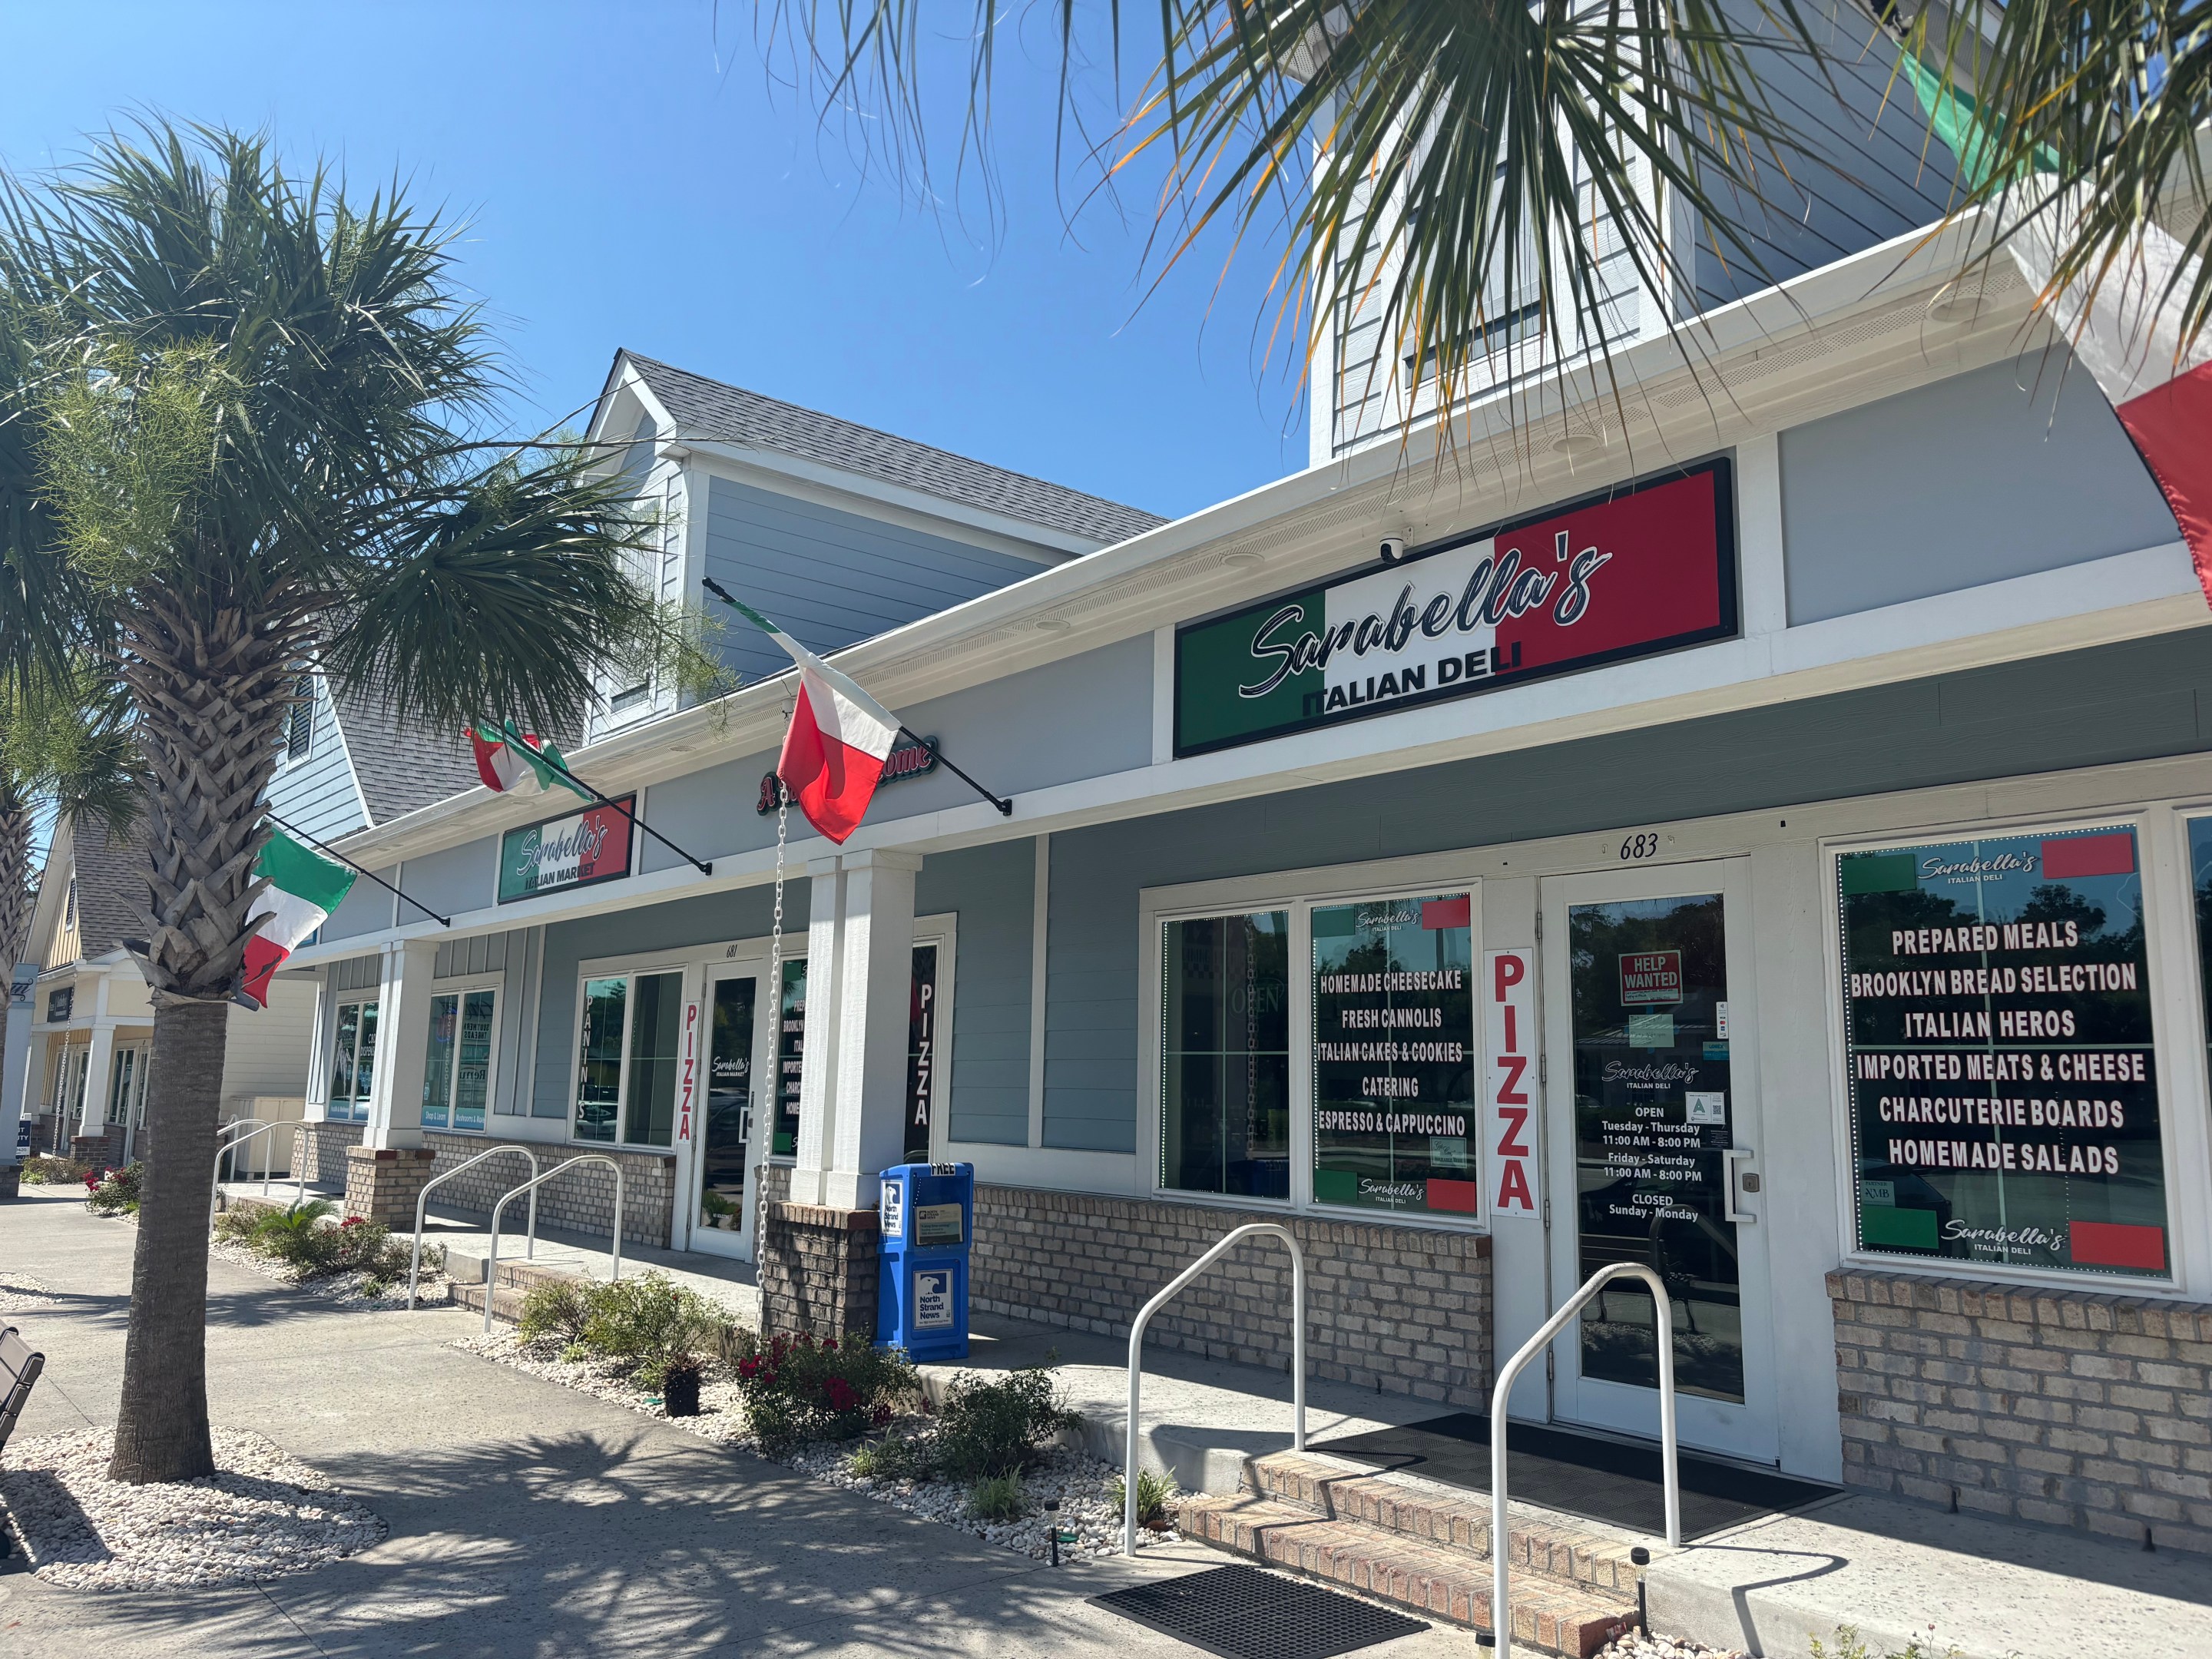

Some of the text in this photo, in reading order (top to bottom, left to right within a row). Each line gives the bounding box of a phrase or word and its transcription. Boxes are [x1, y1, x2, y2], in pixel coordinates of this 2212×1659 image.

[1238, 530, 1613, 698] Sarabella's
[1302, 641, 1521, 717] ITALIAN DELI
[879, 743, 931, 780] ome
[516, 815, 608, 876] Sarabella's
[1620, 833, 1659, 859] 683
[1918, 850, 2041, 879] Sarabella's
[524, 862, 595, 890] ITALIAN MARKET
[1947, 873, 2002, 884] ITALIAN DELI
[1356, 909, 1419, 928] Sarabella's
[1892, 920, 2078, 955] PREPARED MEALS
[726, 945, 737, 959] 681
[1634, 956, 1666, 972] HELP
[1321, 970, 1462, 993] HOMEMADE CHEESECAKE
[1624, 971, 1677, 988] WANTED
[1851, 962, 2137, 997] BROOKLYN BREAD SELECTION
[1231, 987, 1279, 1013] OEN
[1342, 1008, 1442, 1028] FRESH CANNOLIS
[1906, 1009, 2075, 1038] ITALIAN HEROS
[793, 1039, 803, 1052] ITAL
[915, 984, 932, 1125] PIZZA
[1318, 1041, 1463, 1062] ITALIAN CAKES & COOKIES
[578, 995, 594, 1119] PANINIS
[711, 1055, 750, 1074] Sarabella's
[783, 1061, 802, 1074] IMPORTE
[1857, 1053, 2146, 1081] IMPORTED MEATS & CHEESE
[679, 1005, 697, 1140] PIZZA
[1495, 955, 1534, 1210] PIZZA
[1601, 1060, 1699, 1083] Sarabella's
[1362, 1077, 1419, 1097] CATERING
[1635, 1108, 1664, 1118] OPEN
[1879, 1095, 2124, 1128] CHARCUTERIE BOARDS
[1319, 1111, 1465, 1135] ESPRESSO & CAPPUCCINO
[1602, 1121, 1643, 1134] Tuesday
[1651, 1121, 1700, 1135] Thursday
[1603, 1136, 1631, 1145] 11:00
[1632, 1137, 1650, 1146] AM
[1657, 1137, 1681, 1147] 8:00
[1684, 1138, 1700, 1148] PM
[1608, 1153, 1640, 1165] Friday
[1647, 1154, 1695, 1168] Saturday
[1889, 1138, 2118, 1174] HOMEMADE SALADS
[932, 1163, 955, 1175] FREE
[1604, 1167, 1631, 1177] 11:00
[1634, 1168, 1651, 1178] AM
[1659, 1170, 1682, 1181] 8:00
[1685, 1171, 1702, 1181] PM
[1359, 1178, 1424, 1200] Sarabella's
[1632, 1194, 1673, 1206] CLOSED
[884, 1220, 896, 1228] News
[1609, 1204, 1647, 1218] Sunday
[1655, 1208, 1698, 1222] Monday
[1941, 1219, 2067, 1250] Sarabella's
[1974, 1243, 2032, 1255] ITALIAN DELI
[919, 1302, 944, 1311] Strand
